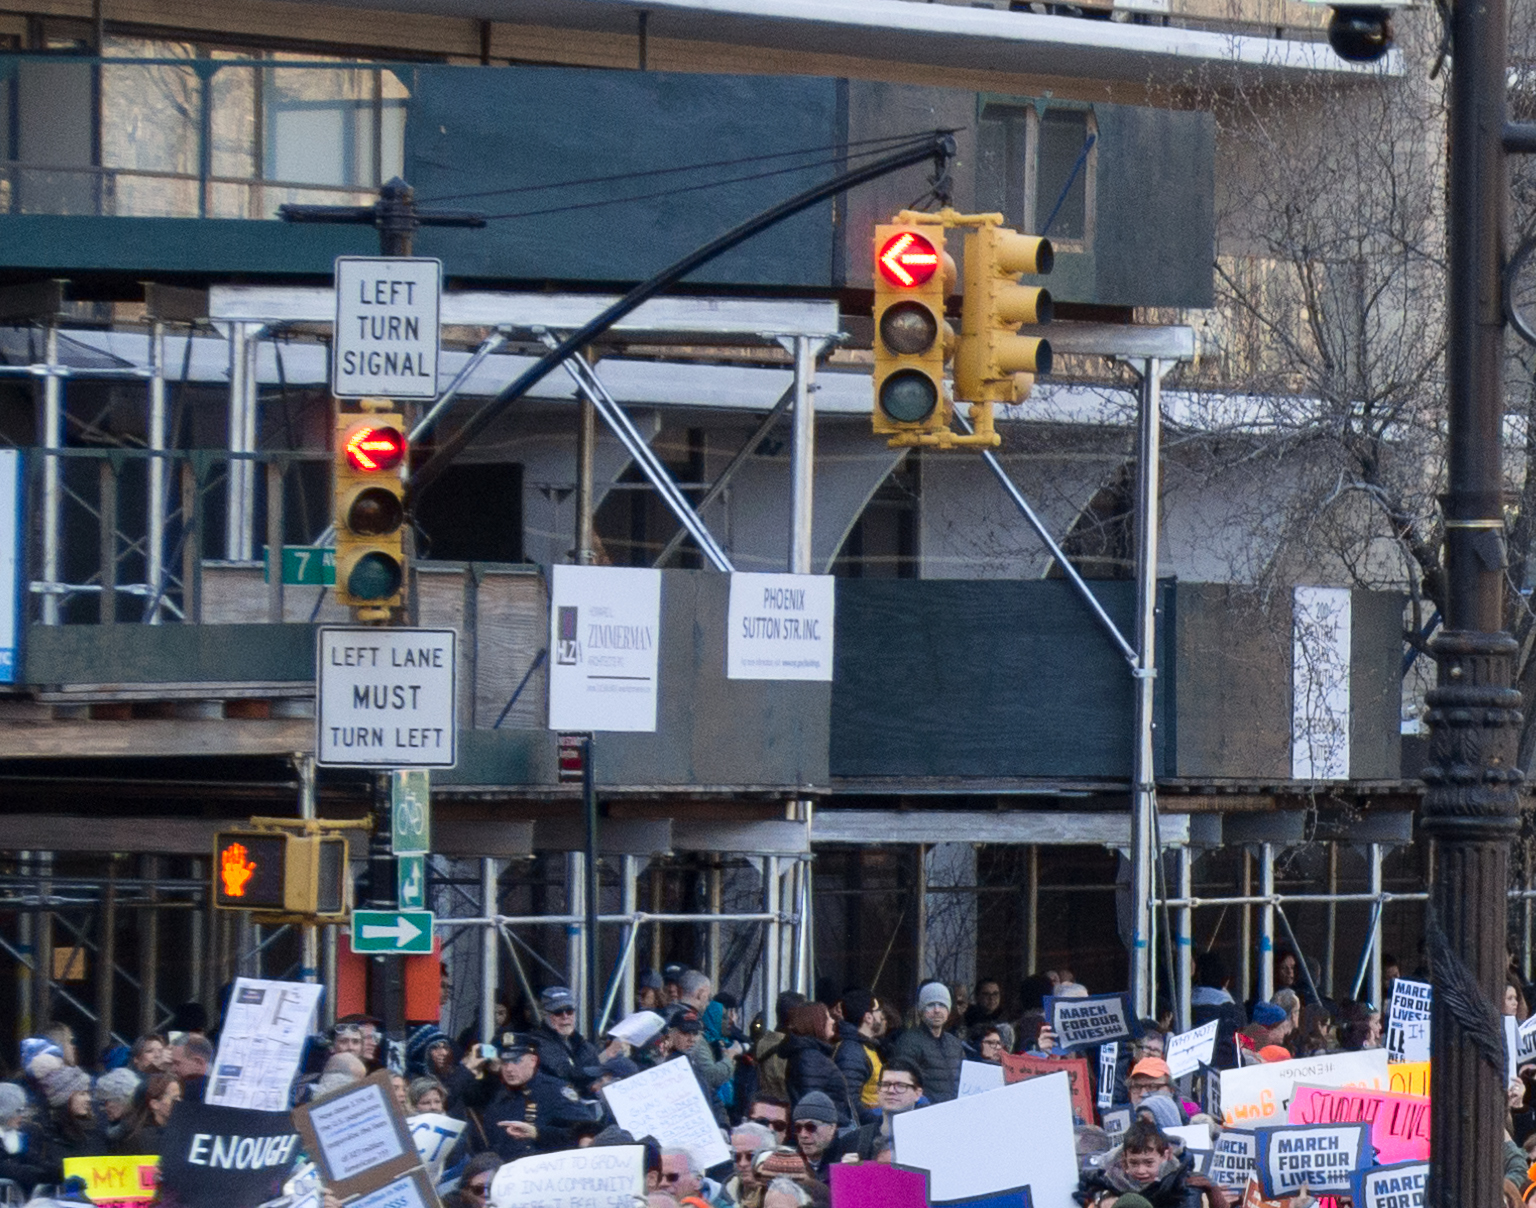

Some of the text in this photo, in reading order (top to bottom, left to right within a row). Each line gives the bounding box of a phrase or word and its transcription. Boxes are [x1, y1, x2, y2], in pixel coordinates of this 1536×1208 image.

[360, 280, 417, 305] LEFT
[356, 315, 419, 341] TURN
[343, 352, 430, 377] SIGNAL
[293, 551, 311, 581] 7
[763, 587, 806, 611] PHOENIX
[742, 616, 780, 640] SUTTON
[331, 648, 444, 668] LEFT LANE
[353, 686, 421, 711] MUST
[330, 727, 444, 748] TURN LEFT
[1060, 1004, 1108, 1020] MARCH
[1062, 1014, 1120, 1031] FOR OUR
[1064, 1027, 1103, 1043] LIVES
[1300, 1091, 1384, 1124] STUDENT
[188, 1134, 299, 1170] ENOUGH
[1276, 1137, 1341, 1156] MARCH
[1278, 1152, 1350, 1171] FOR OUR
[92, 1167, 126, 1189] MY
[1280, 1169, 1327, 1187] LIVES
